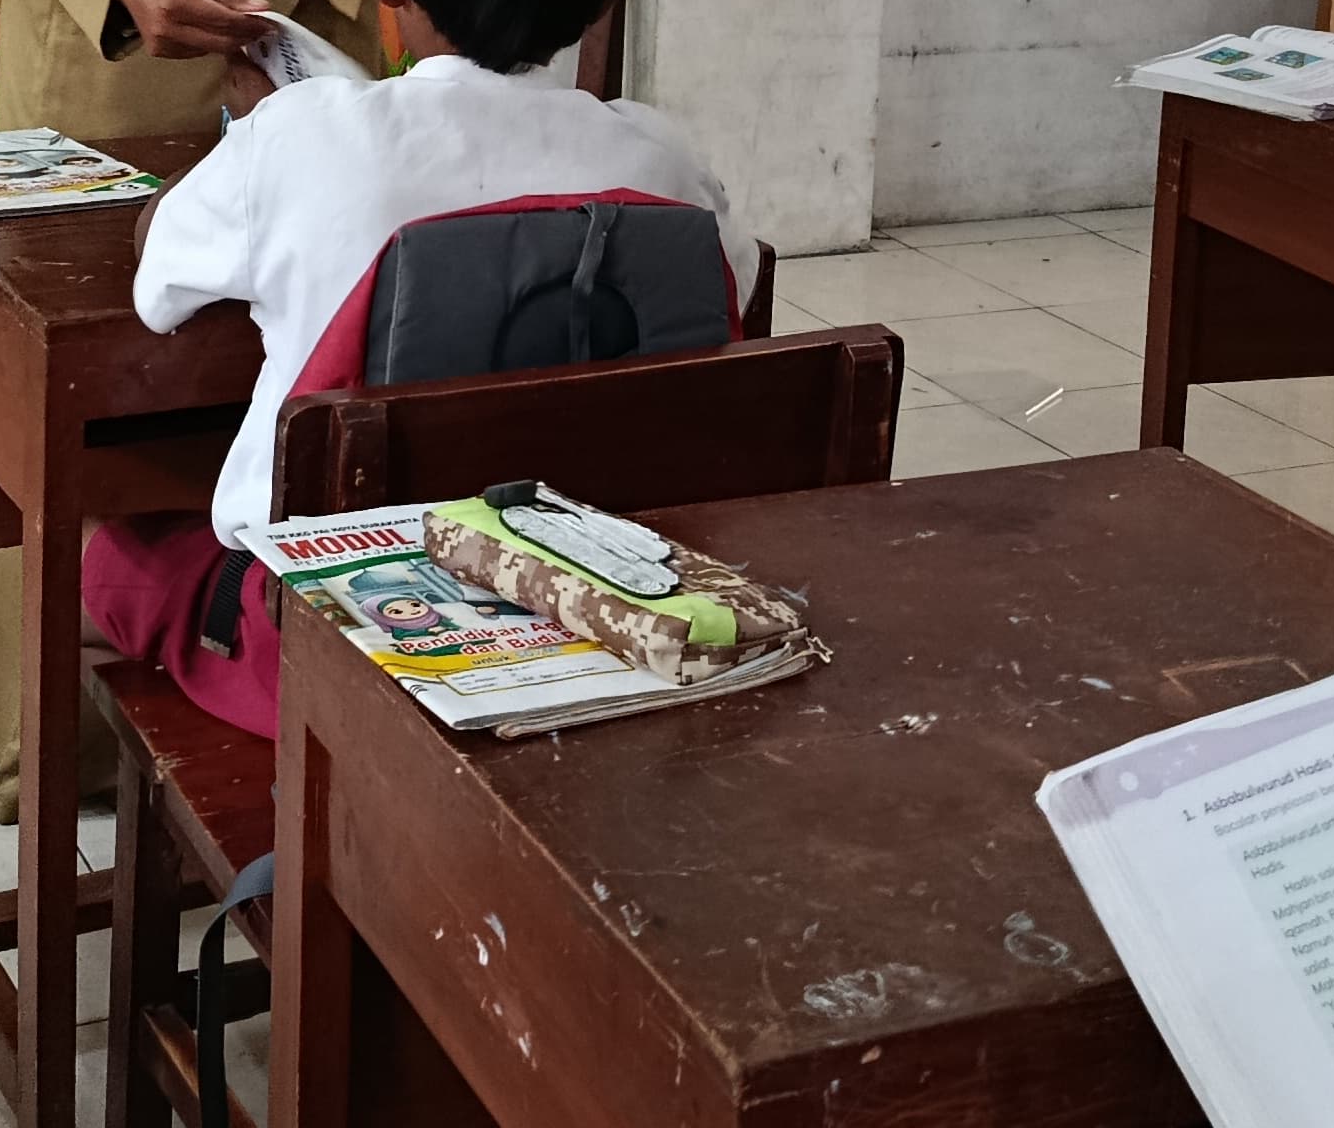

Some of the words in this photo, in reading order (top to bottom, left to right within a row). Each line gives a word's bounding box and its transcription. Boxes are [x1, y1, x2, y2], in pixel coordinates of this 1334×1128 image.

[275, 528, 417, 559] MODUL
[400, 626, 525, 652] Pendidikan
[530, 622, 562, 633] Ag
[461, 642, 504, 655] dan
[507, 632, 558, 649] Budi
[471, 656, 511, 665] untuk
[1204, 772, 1294, 813] Asbabulwurud
[1295, 759, 1332, 778] Hadis
